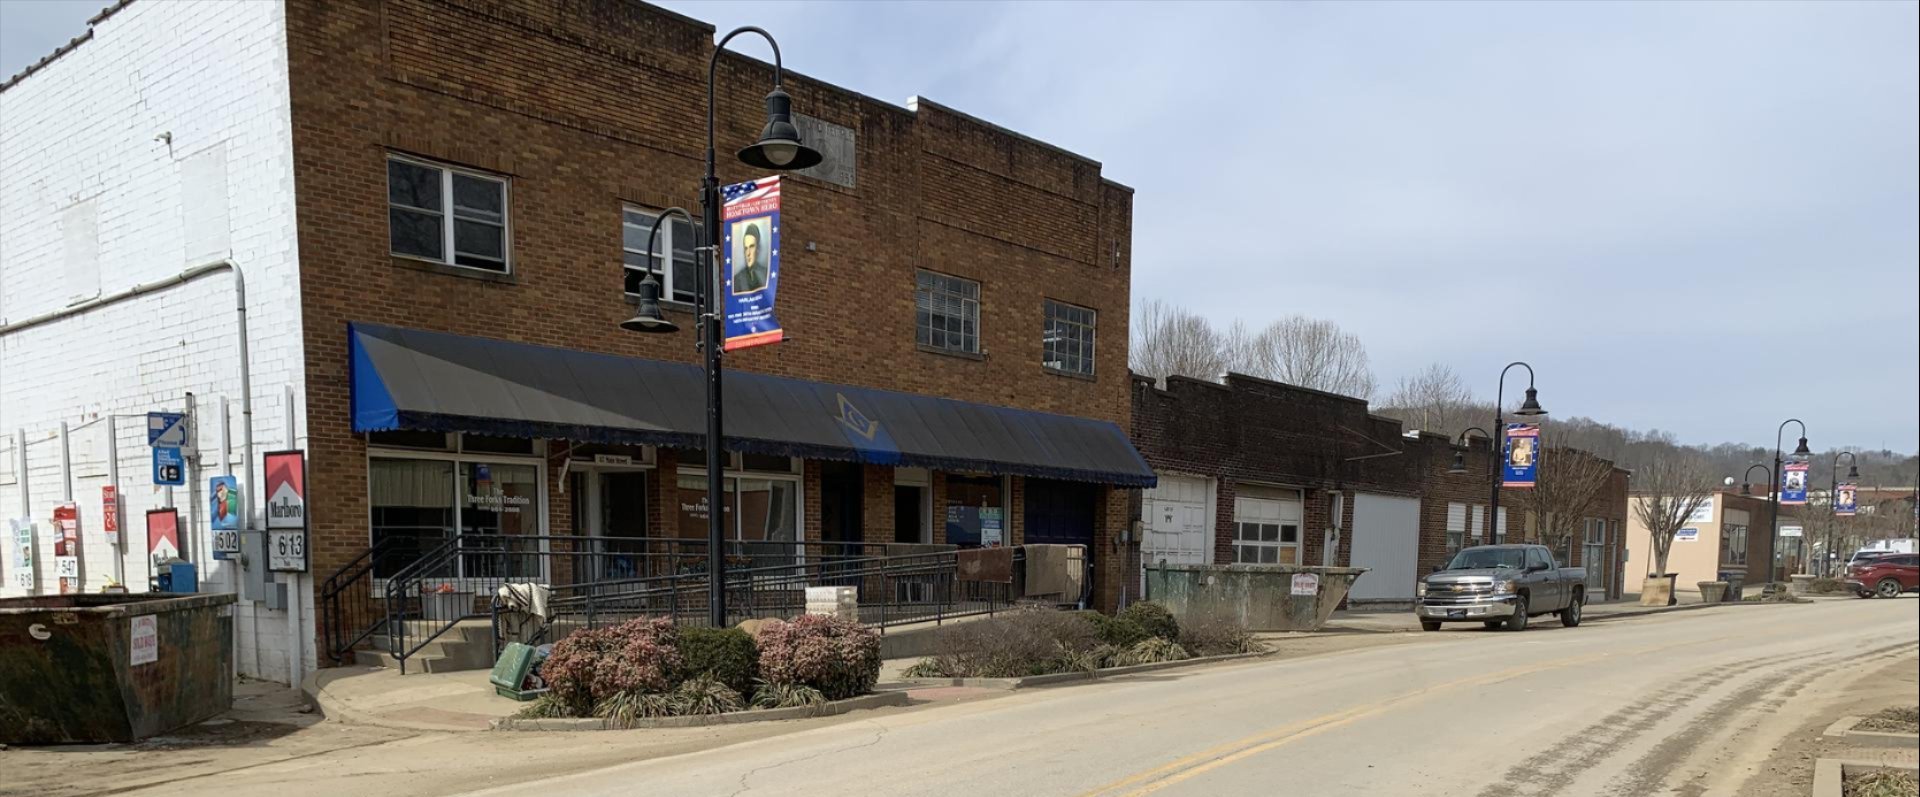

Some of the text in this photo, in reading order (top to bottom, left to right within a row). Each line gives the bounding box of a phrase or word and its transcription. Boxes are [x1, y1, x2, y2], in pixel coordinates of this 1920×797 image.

[726, 206, 760, 219] HOMETOWN
[493, 487, 504, 496] The
[467, 494, 530, 505] Three Forks Tradition
[270, 497, 302, 518] Marlboro
[219, 531, 237, 549] 502
